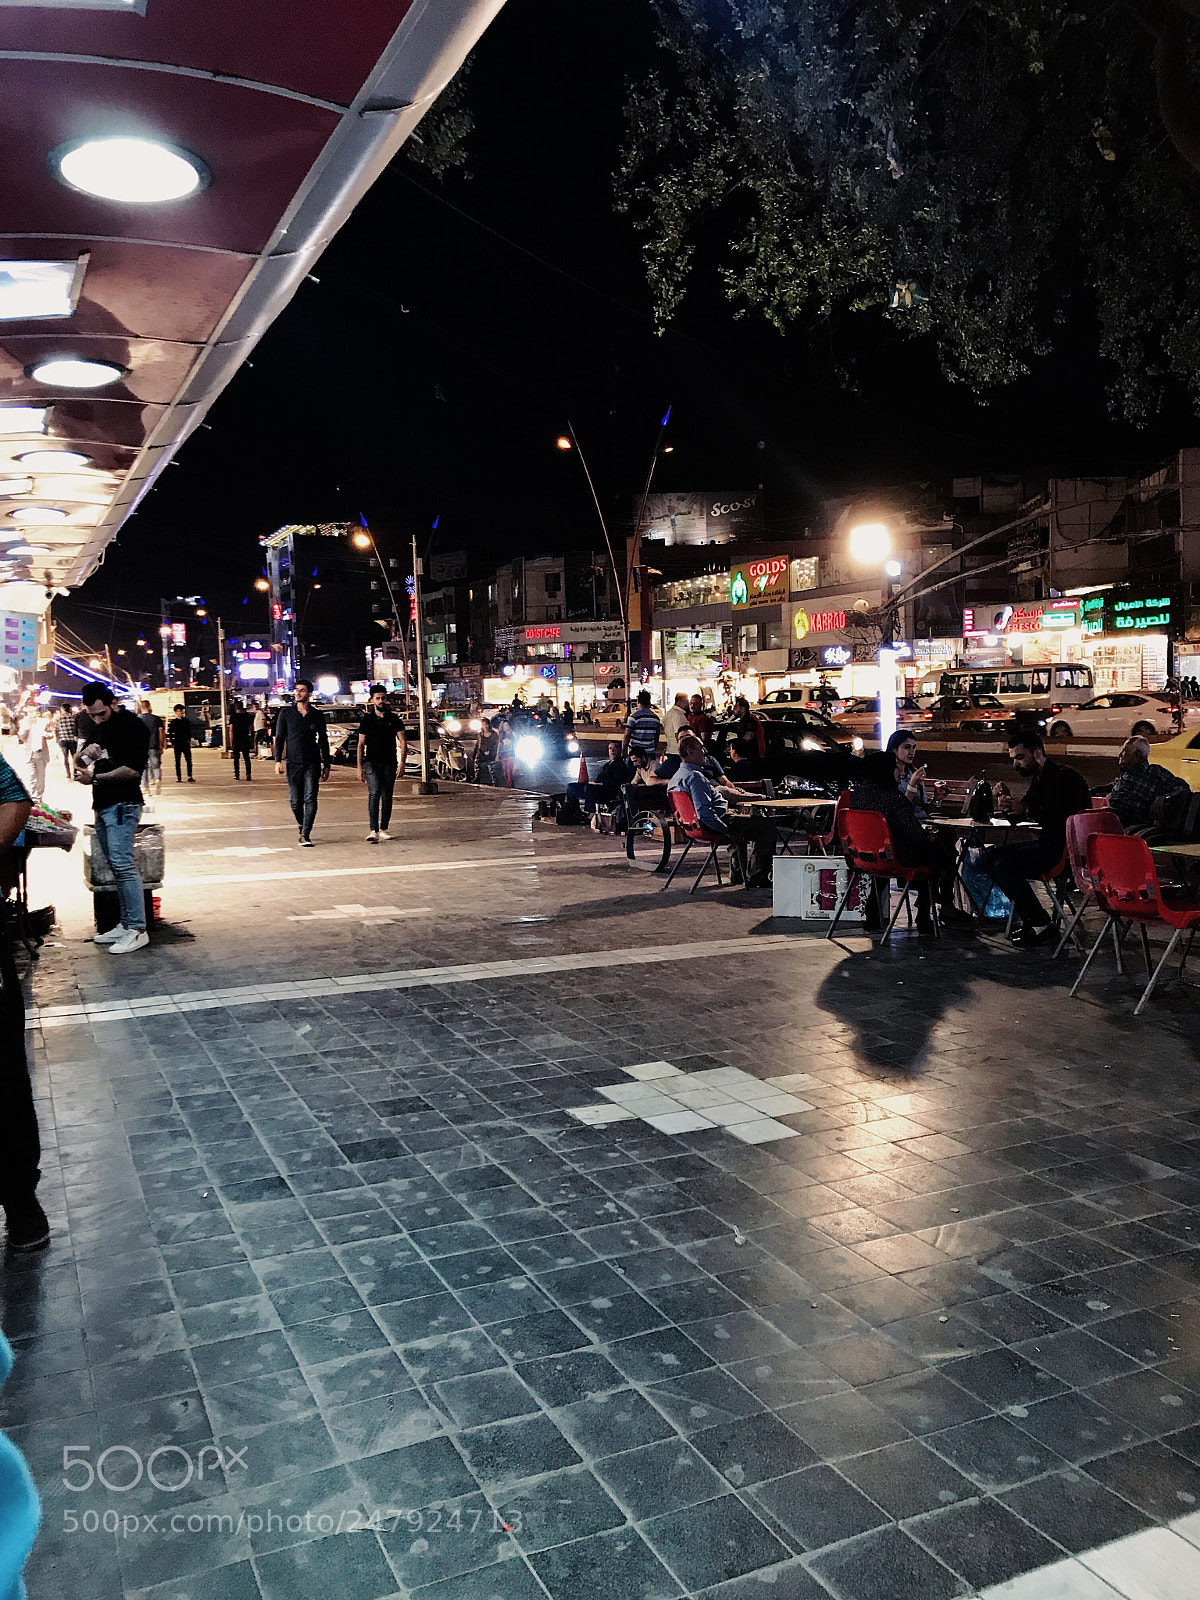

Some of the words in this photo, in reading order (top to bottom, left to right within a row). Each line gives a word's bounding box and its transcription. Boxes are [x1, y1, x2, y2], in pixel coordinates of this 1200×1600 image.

[749, 559, 787, 577] GOLDS
[544, 627, 560, 638] CAFE
[1007, 622, 1043, 633] FRESCO
